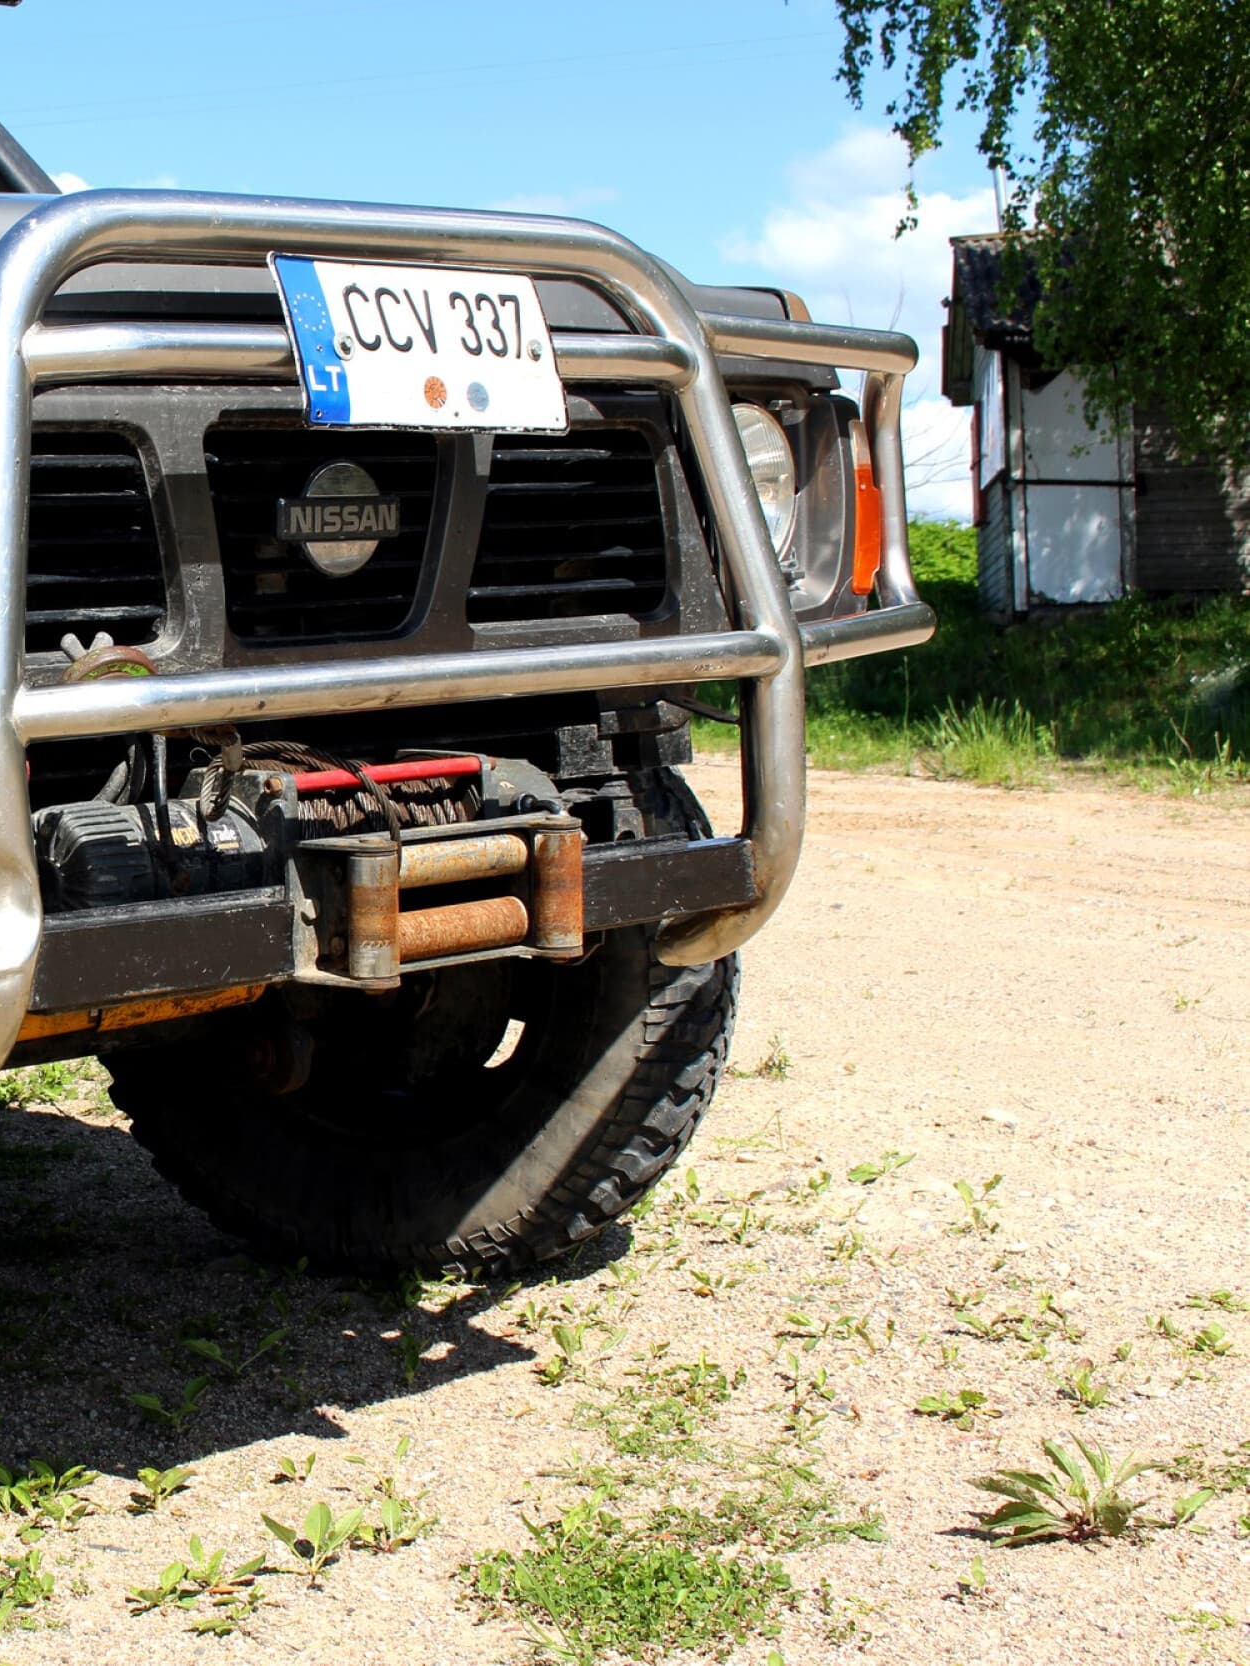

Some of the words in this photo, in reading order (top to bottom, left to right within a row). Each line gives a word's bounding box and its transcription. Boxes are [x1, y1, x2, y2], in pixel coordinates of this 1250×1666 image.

[343, 285, 438, 355] CCV
[449, 291, 522, 360] 337
[308, 364, 341, 393] LT
[290, 503, 397, 534] NISSAN
